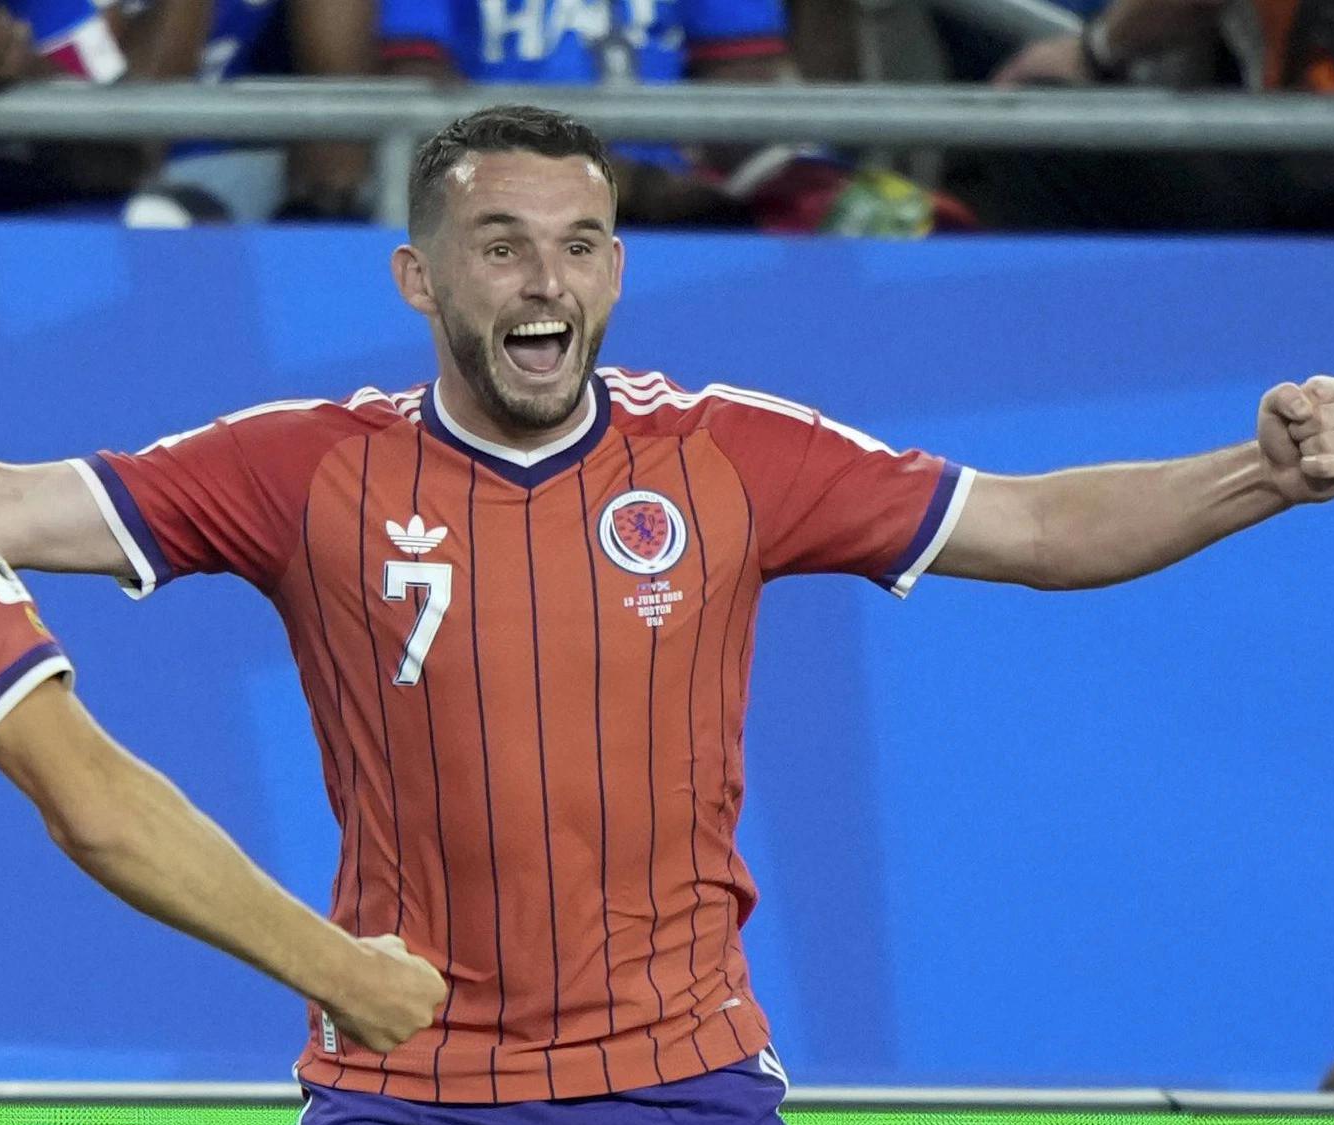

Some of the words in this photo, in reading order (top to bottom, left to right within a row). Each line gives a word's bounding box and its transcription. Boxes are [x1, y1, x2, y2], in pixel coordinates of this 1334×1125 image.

[637, 594, 660, 606] JUNE
[637, 604, 671, 617] BOSTON
[382, 561, 452, 686] 7
[646, 616, 664, 627] USA
